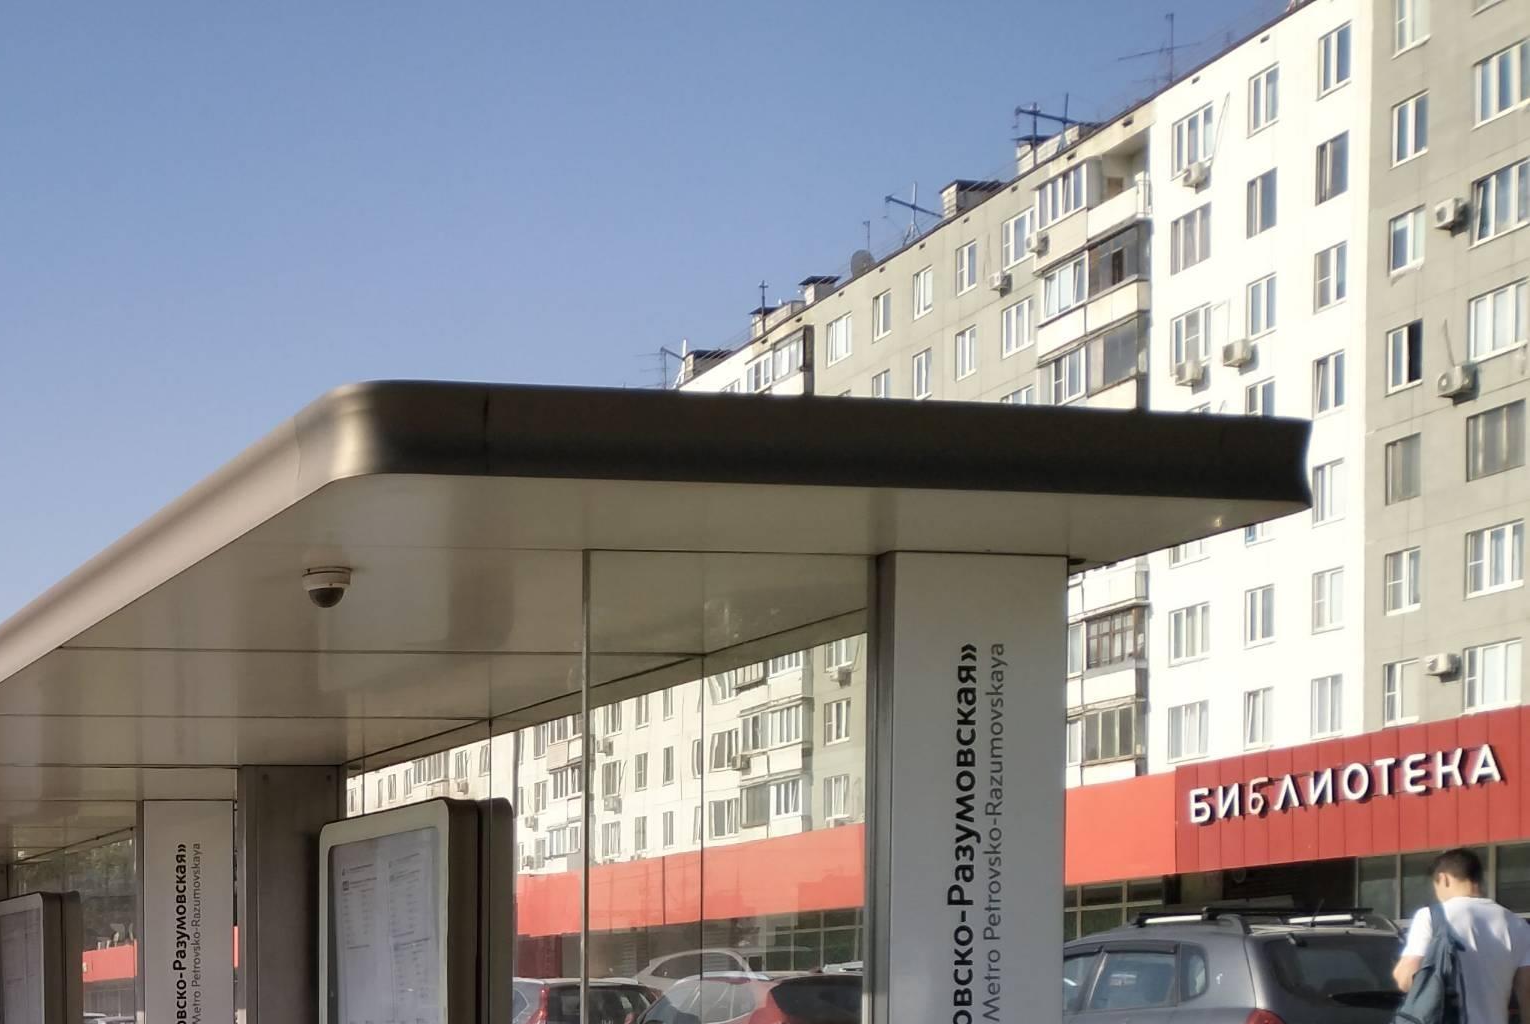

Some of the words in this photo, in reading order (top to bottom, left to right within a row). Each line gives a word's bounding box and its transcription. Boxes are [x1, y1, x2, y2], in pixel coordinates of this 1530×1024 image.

[983, 643, 1008, 941] Petrovsko-Razumovskaya
[1190, 744, 1501, 823] БИБЛИОТЕКА
[191, 843, 203, 987] Petrovsko-Razumovskaya
[982, 949, 1001, 1022] Metro
